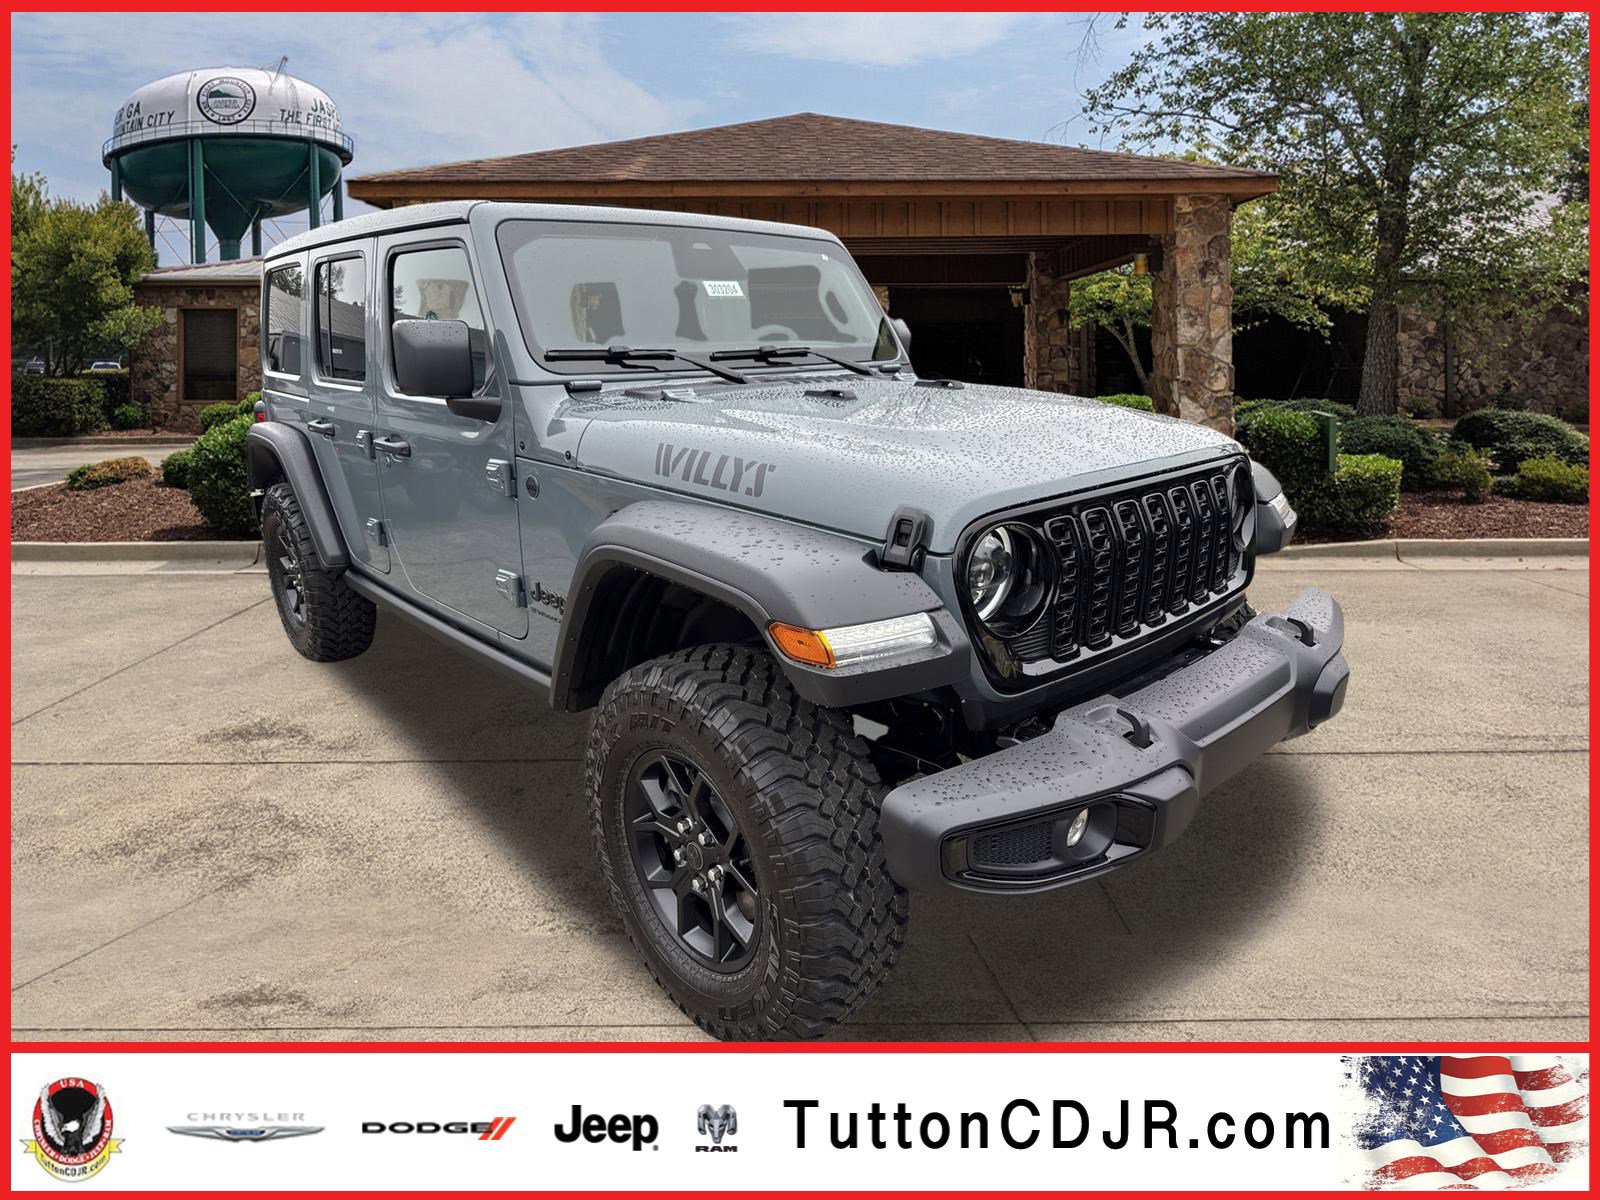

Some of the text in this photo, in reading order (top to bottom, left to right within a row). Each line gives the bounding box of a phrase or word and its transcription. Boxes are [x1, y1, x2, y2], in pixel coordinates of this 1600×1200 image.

[127, 101, 141, 119] GA
[147, 110, 175, 127] CITY
[280, 109, 302, 124] THE
[306, 113, 332, 130] FIRST
[655, 443, 777, 497] WILLYS
[530, 582, 567, 615] Jeep
